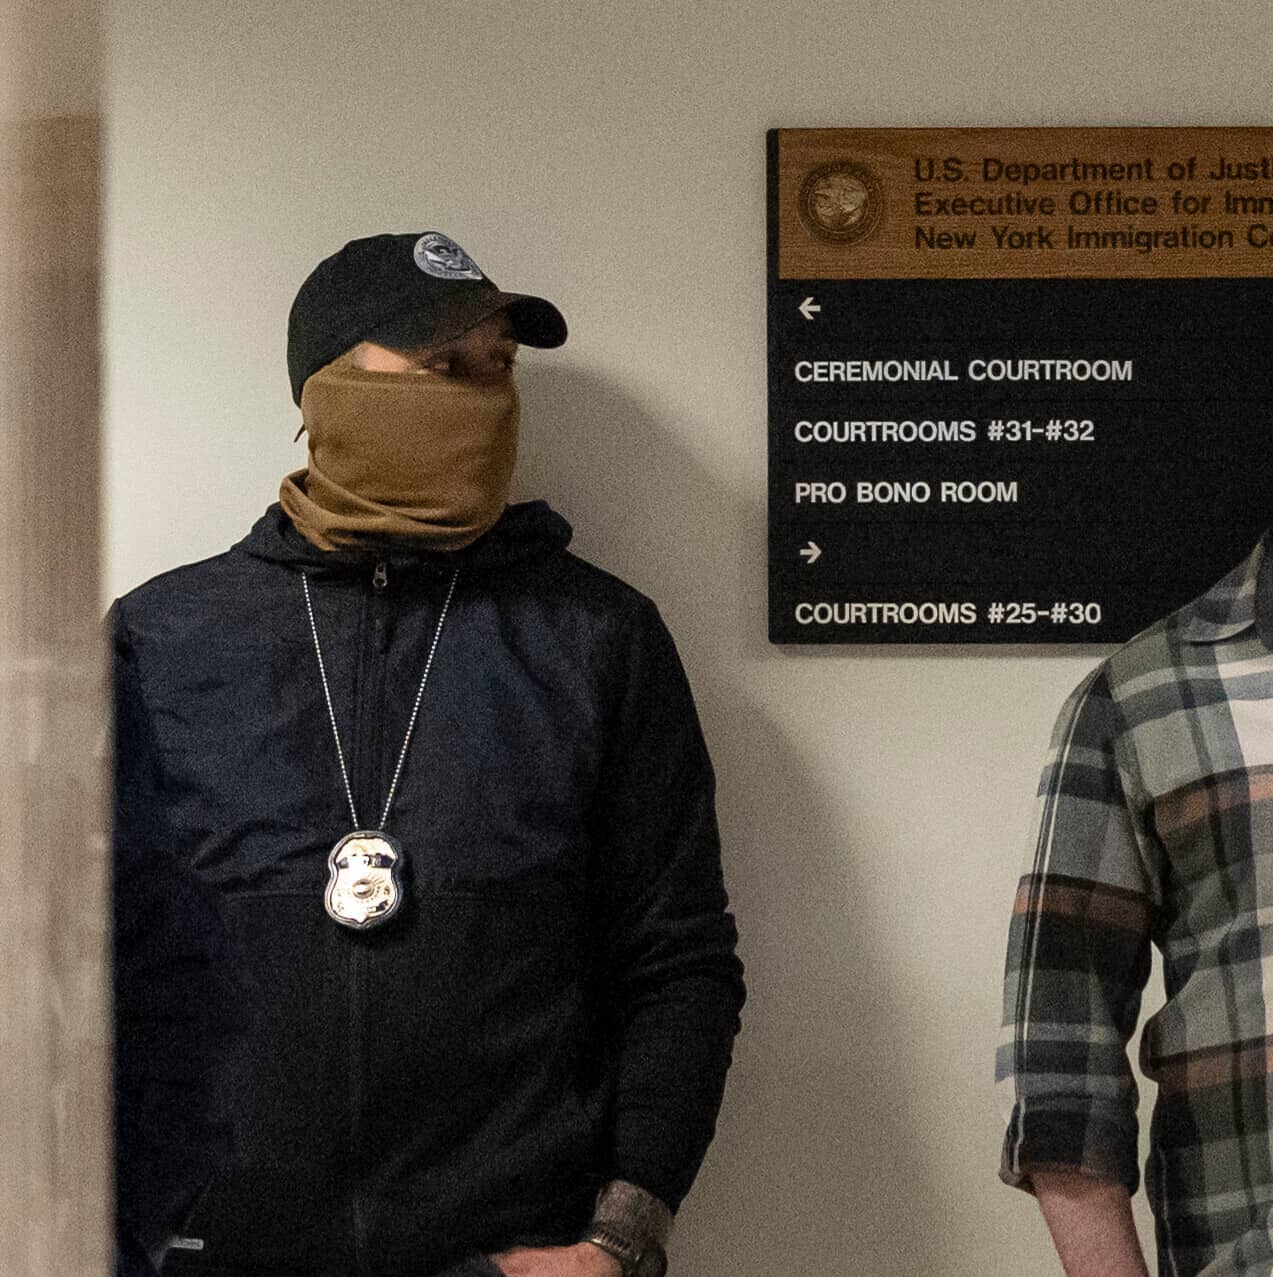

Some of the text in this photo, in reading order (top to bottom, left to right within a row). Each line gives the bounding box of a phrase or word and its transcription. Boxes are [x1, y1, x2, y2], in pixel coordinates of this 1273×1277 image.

[914, 157, 969, 183] U.S.
[982, 157, 1154, 186] Department
[1166, 156, 1197, 181] of
[914, 191, 1055, 216] Executive
[1068, 190, 1158, 216] Office
[1171, 190, 1212, 215] for
[915, 225, 977, 250] New
[991, 225, 1054, 250] York
[1067, 224, 1234, 255] Immigration
[794, 359, 1133, 383] CEREMONIAL COURTROOM
[794, 420, 977, 443] COURTROOMS
[795, 481, 1018, 504] PRO BONO ROOM
[795, 602, 977, 625] COURTROOMS
